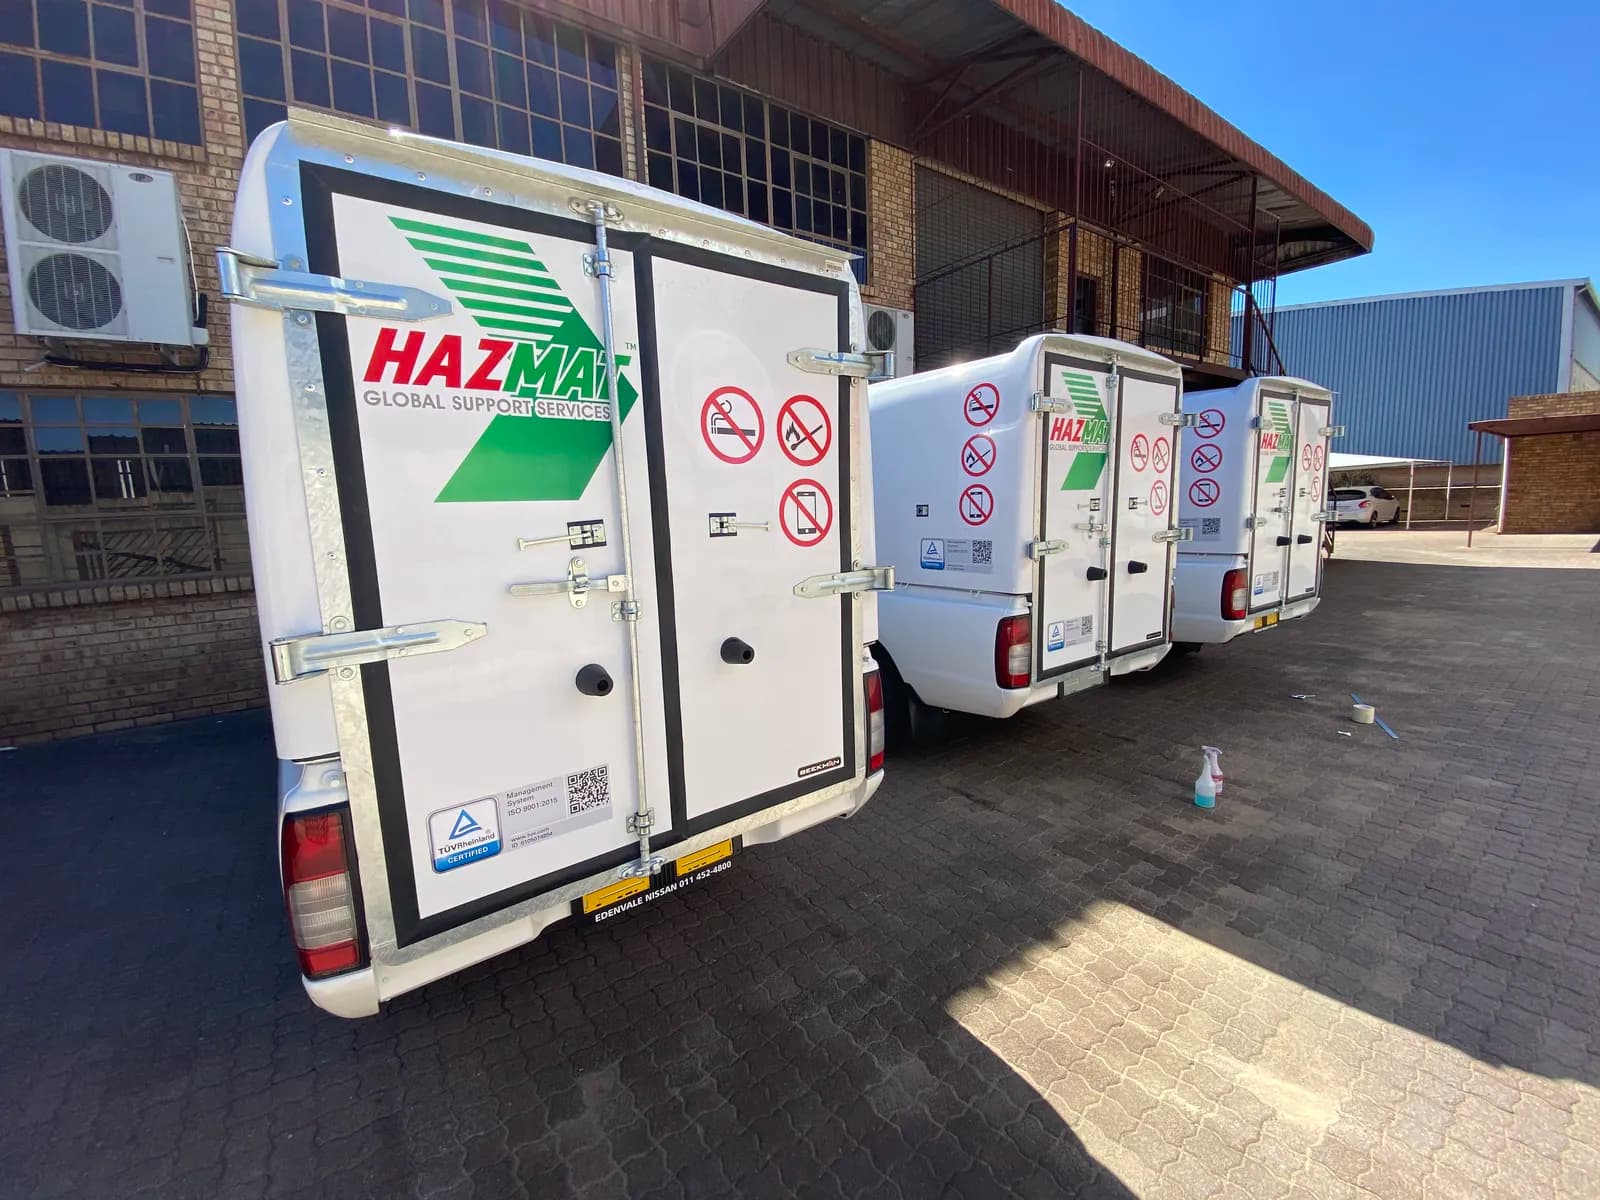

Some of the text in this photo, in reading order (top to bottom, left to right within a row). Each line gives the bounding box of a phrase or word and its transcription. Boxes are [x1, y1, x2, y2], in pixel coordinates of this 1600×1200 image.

[363, 326, 633, 402] HAZMAT
[363, 390, 611, 420] GLOBAL SUPPORT SERVICES
[506, 782, 553, 800] Management
[507, 795, 534, 808] System
[508, 797, 558, 817] ISO 9001:2015
[447, 846, 489, 864] CERTIFIED
[594, 861, 732, 923] EDENVALE NISSAN 011 452-4800
